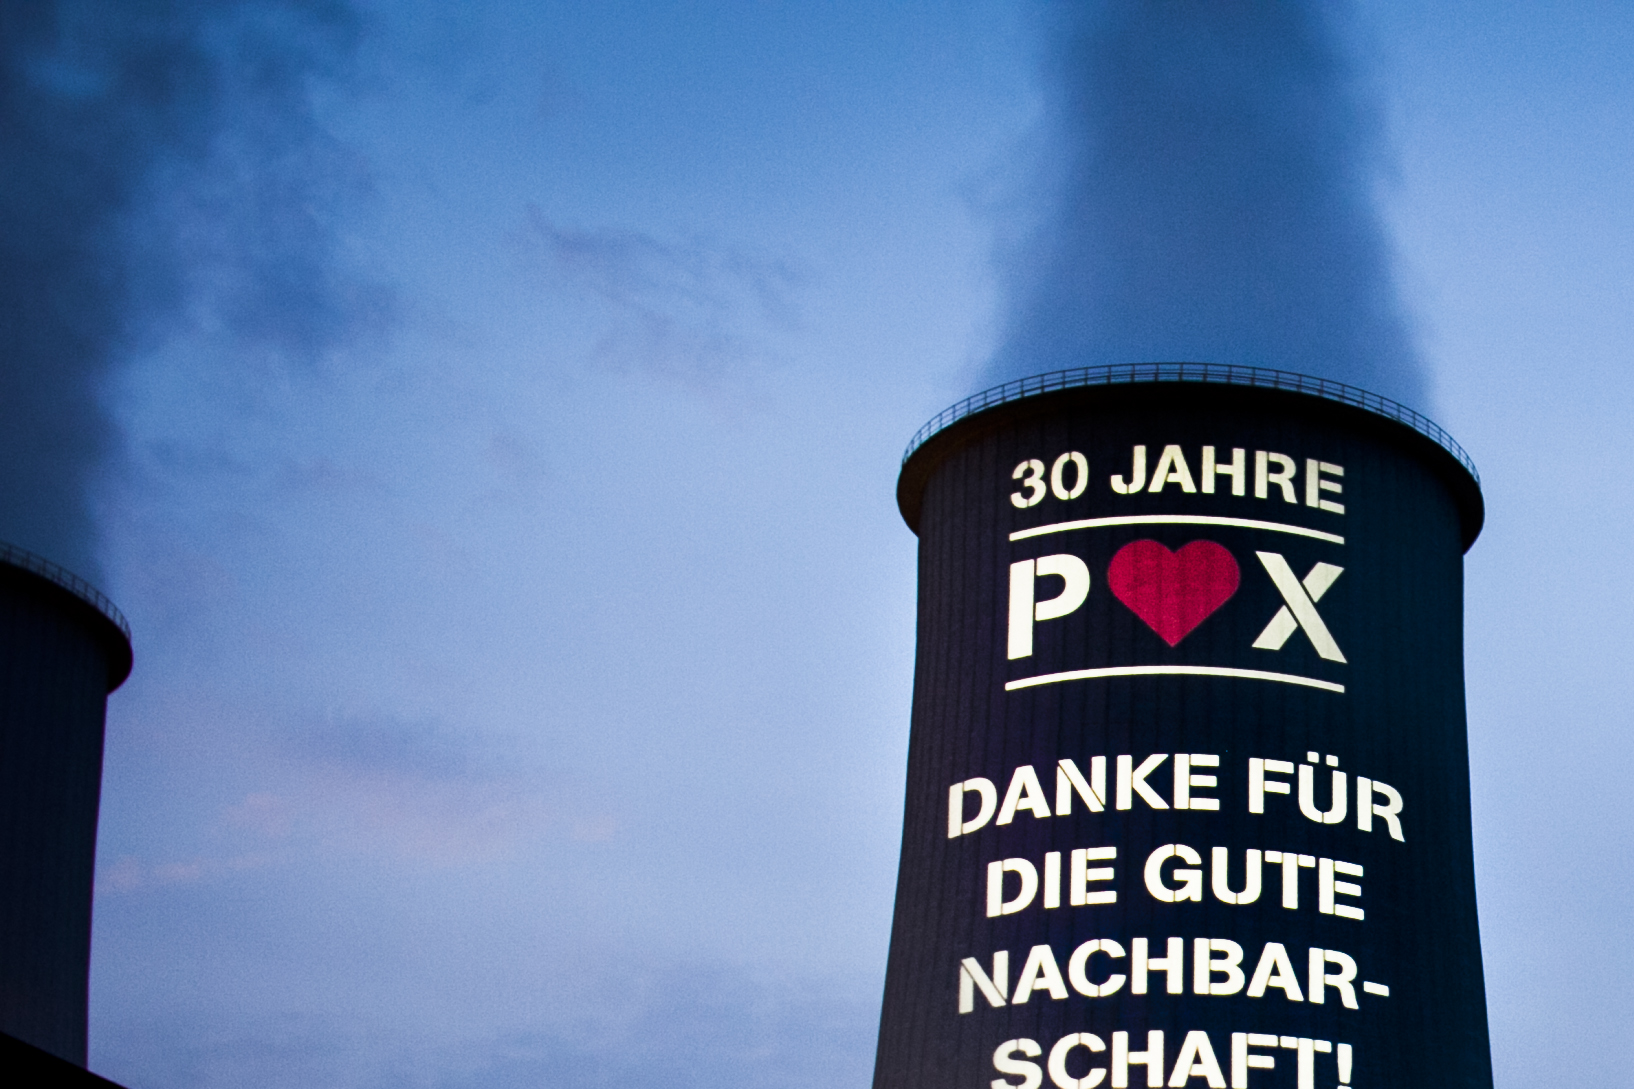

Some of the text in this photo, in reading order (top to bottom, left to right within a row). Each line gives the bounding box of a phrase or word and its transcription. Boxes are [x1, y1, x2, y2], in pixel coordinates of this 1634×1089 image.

[1010, 444, 1345, 515] 30 JAHRE
[947, 750, 1405, 843] DANKE FÜR
[986, 843, 1365, 921] DIE GUTE
[958, 936, 1390, 1015] NACHBAR-
